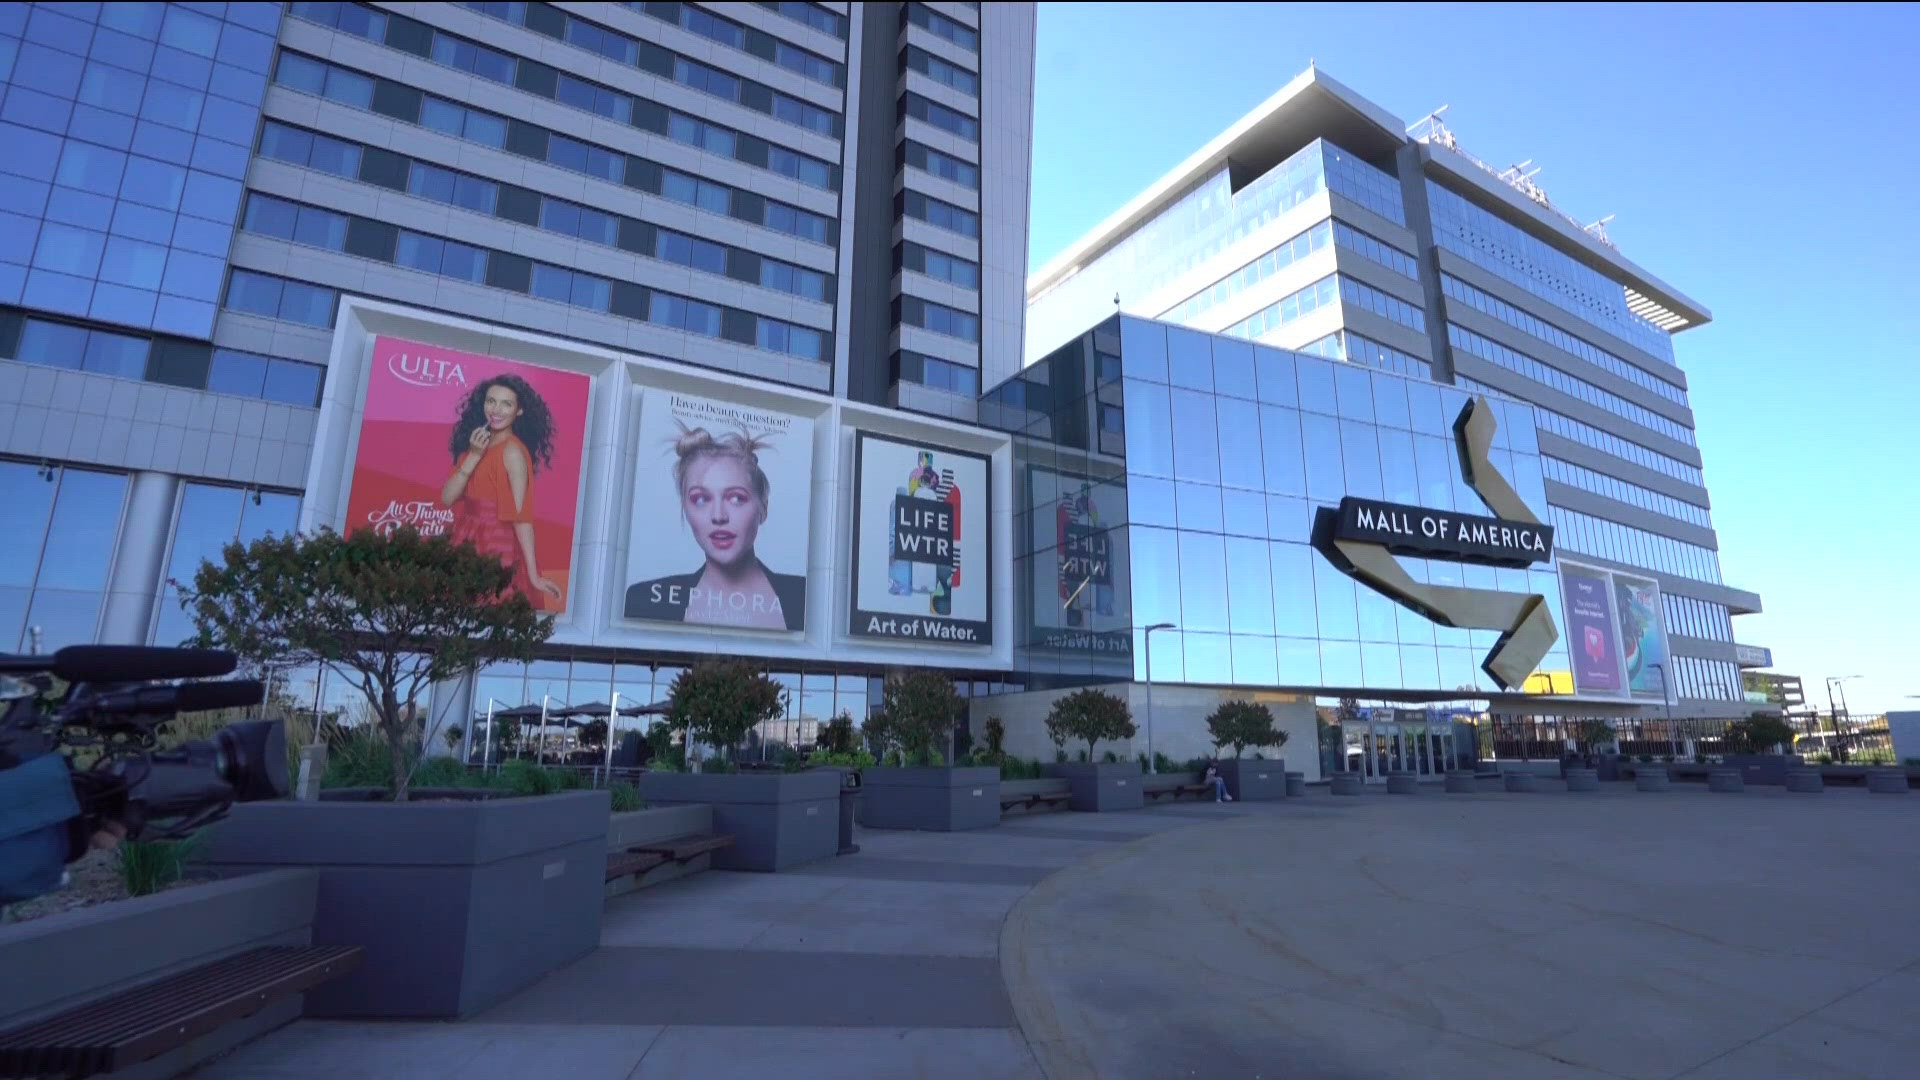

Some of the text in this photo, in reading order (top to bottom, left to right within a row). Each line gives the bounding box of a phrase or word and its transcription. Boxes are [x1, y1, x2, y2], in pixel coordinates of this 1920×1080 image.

[401, 353, 466, 384] ULTA
[670, 395, 696, 410] Have
[697, 403, 704, 412] a
[704, 402, 740, 419] beauty
[742, 411, 791, 428] question?
[368, 500, 454, 525] All Things
[900, 507, 948, 532] LIFE
[375, 519, 445, 541] Buty
[1357, 507, 1546, 553] MALL OF AMERICA
[899, 532, 949, 557] WTR
[650, 583, 783, 615] SEPHORA
[867, 616, 977, 641] Art of Water.
